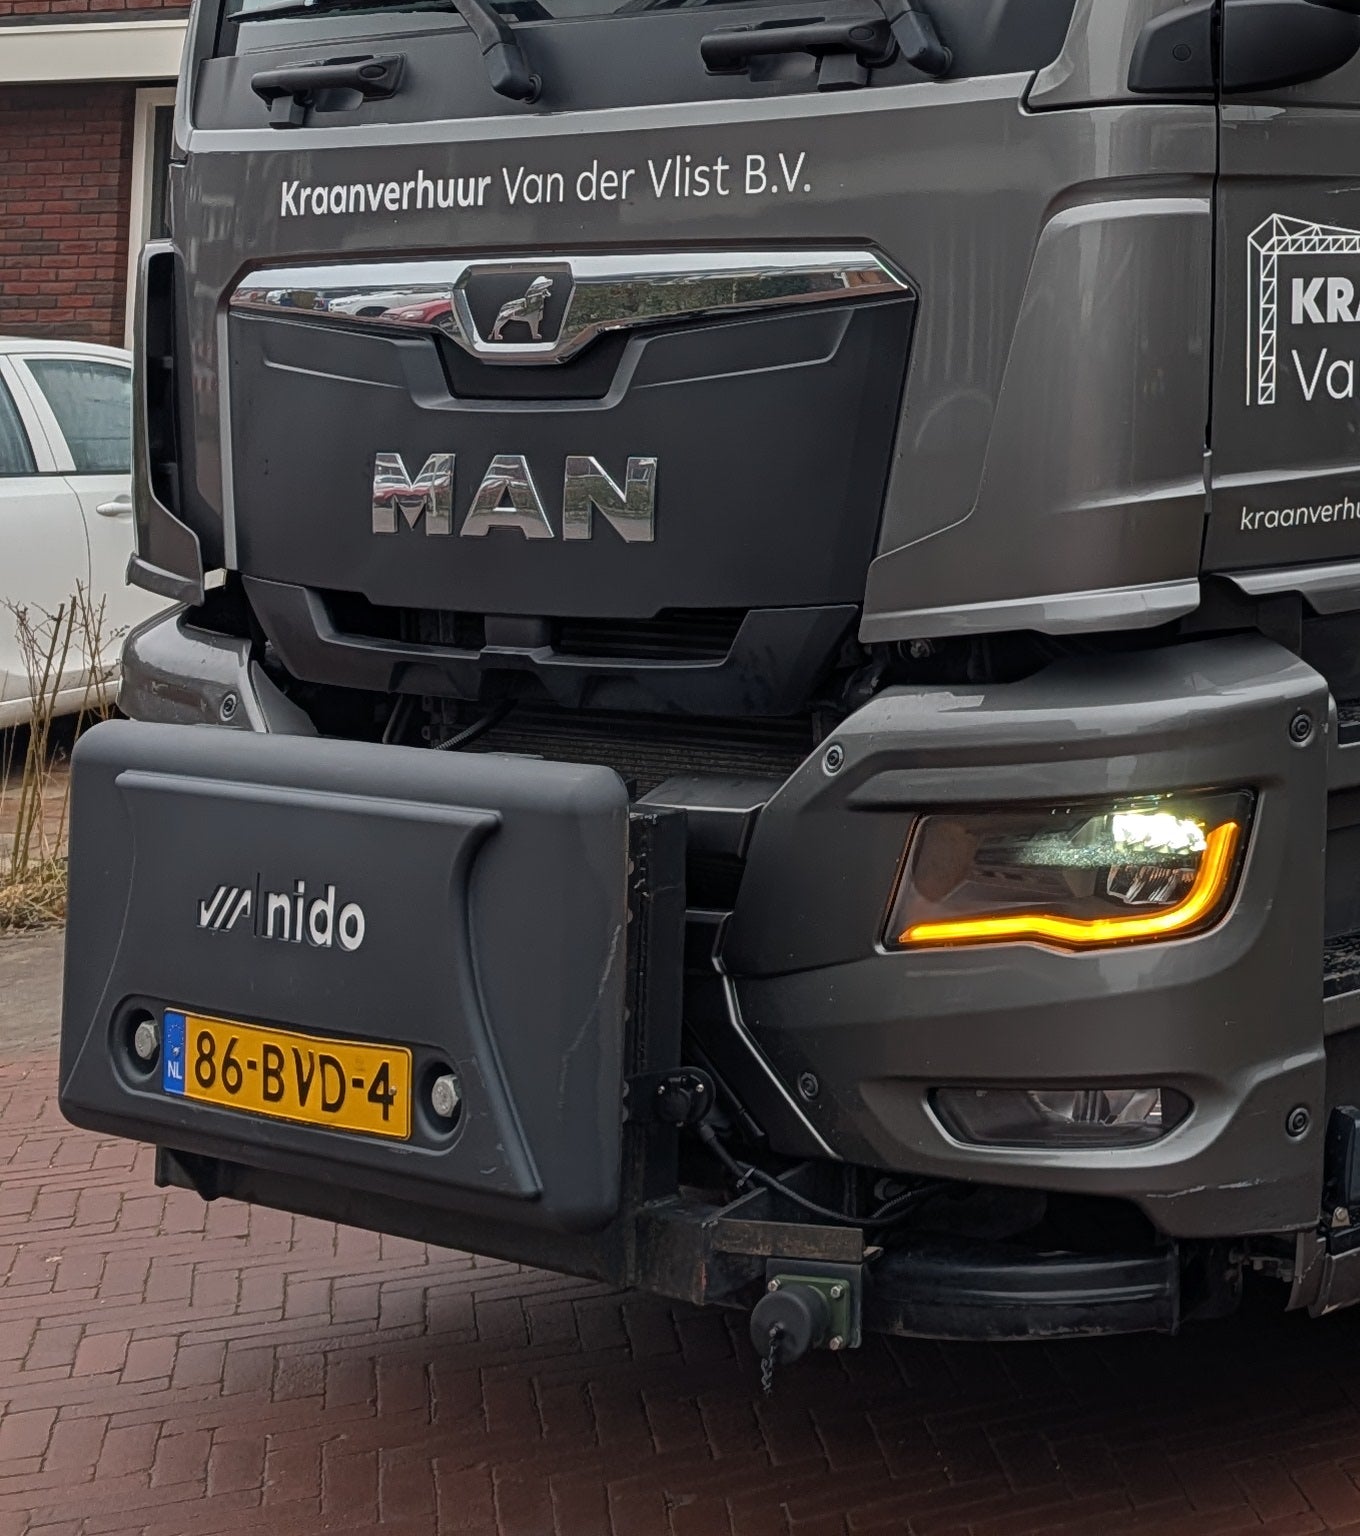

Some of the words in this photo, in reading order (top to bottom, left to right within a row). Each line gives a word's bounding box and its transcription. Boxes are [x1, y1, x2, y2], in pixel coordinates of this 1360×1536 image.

[280, 169, 492, 217] Kraanverhuur
[502, 166, 564, 205] Van
[576, 159, 636, 202] der
[647, 154, 730, 198] Vlist
[745, 151, 811, 195] B.V.
[372, 452, 658, 543] MAN
[267, 880, 366, 951] nido
[167, 1059, 183, 1081] NL
[193, 1028, 396, 1123] 86-BVD-4
